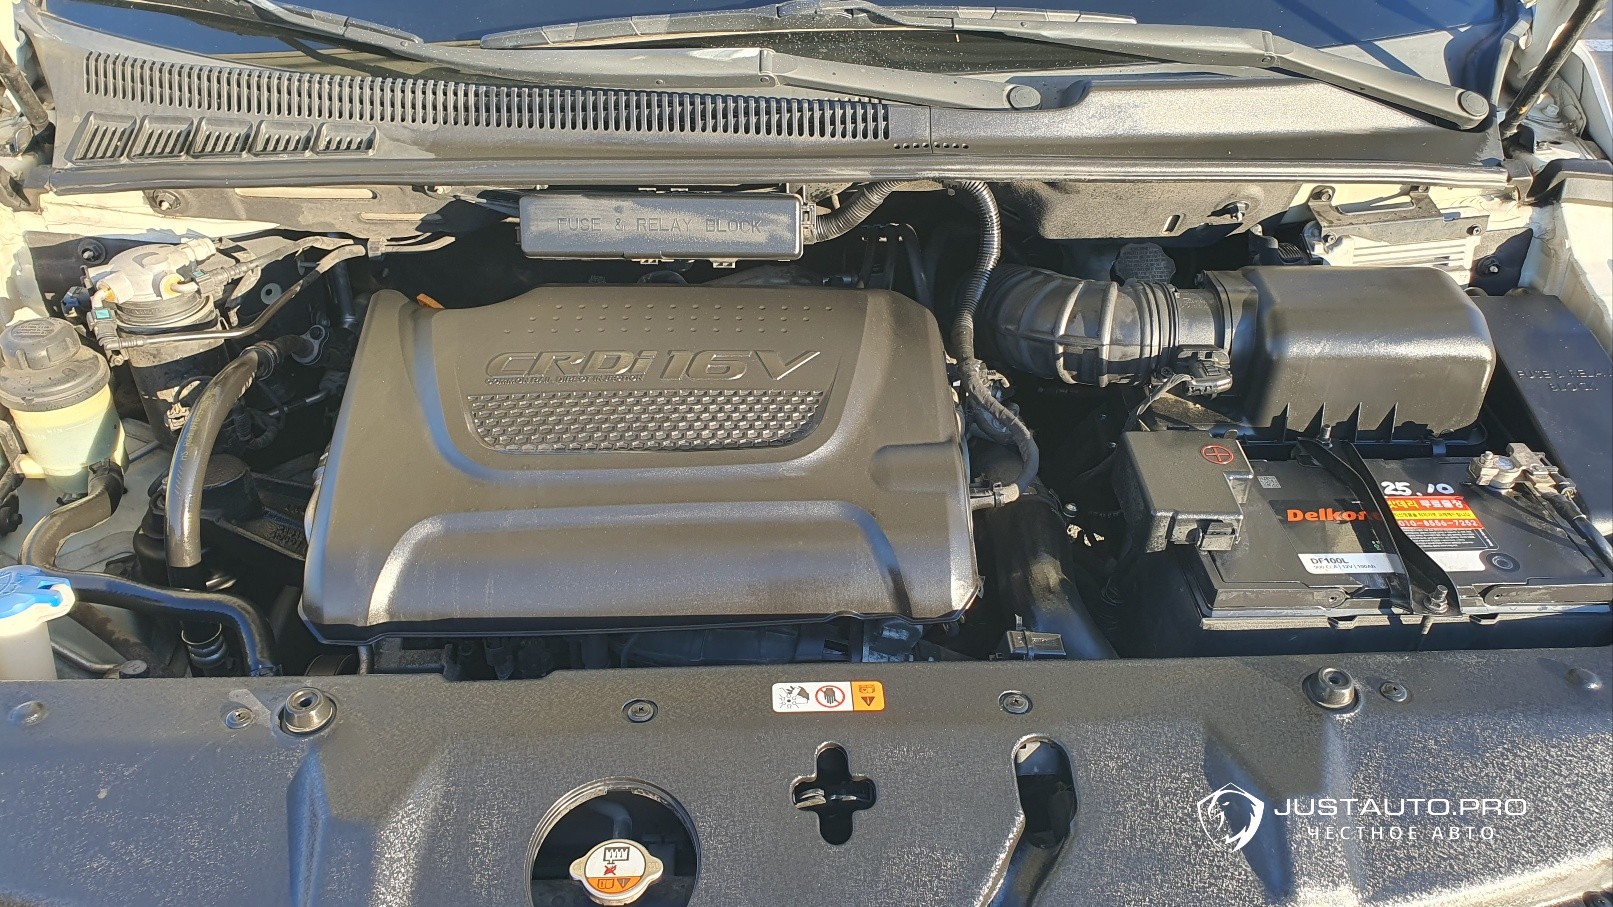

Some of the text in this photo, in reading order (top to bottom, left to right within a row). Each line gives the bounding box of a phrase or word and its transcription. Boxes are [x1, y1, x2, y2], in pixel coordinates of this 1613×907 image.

[557, 217, 763, 233] FUSE & RELAY BLOCK
[485, 350, 821, 381] CRDi 16V
[1310, 557, 1349, 565] DF100L
